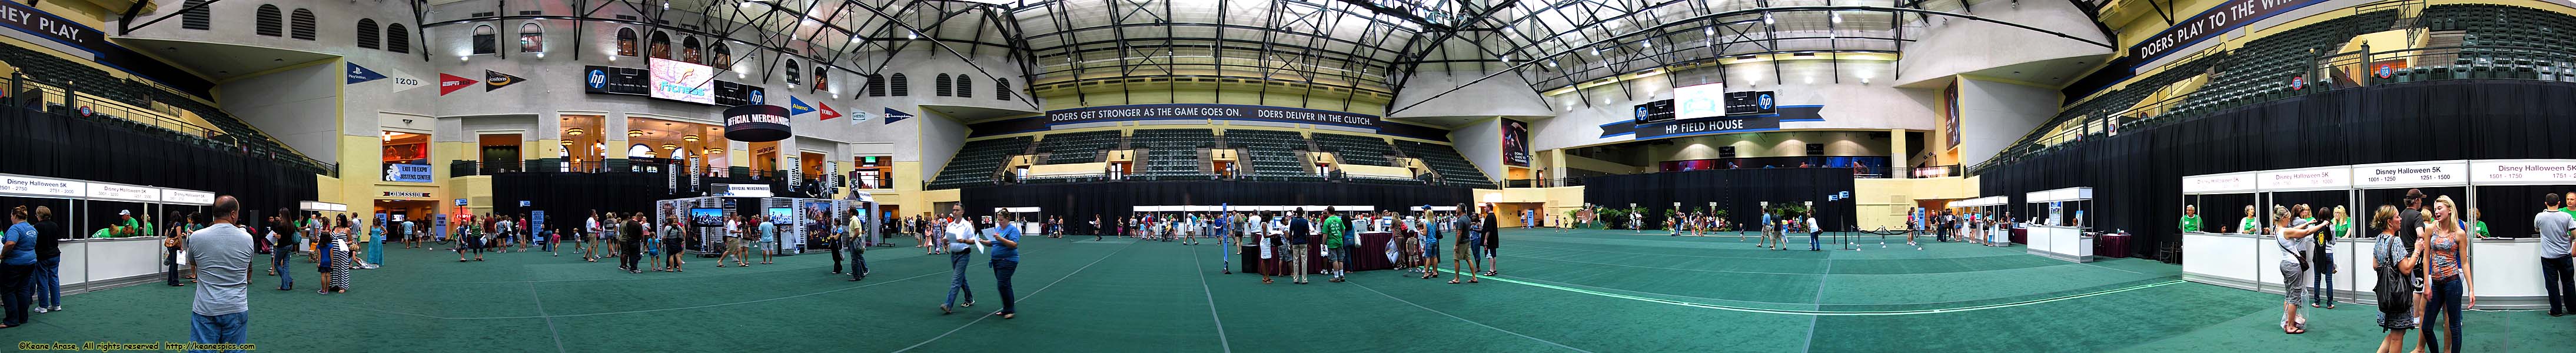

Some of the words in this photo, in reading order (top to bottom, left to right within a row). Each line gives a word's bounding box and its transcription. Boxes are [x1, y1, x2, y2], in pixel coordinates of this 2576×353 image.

[39, 16, 82, 42] PLAY.
[2141, 34, 2173, 59] DOERS
[2178, 19, 2205, 43] PLAY
[2209, 11, 2226, 29] TO
[2231, 0, 2255, 21] THE
[590, 69, 604, 88] hp
[751, 89, 762, 105] hp
[1760, 95, 1771, 110] hp
[792, 103, 808, 111] Alamo
[1052, 112, 1078, 121] DOERS
[1081, 111, 1096, 119] GET
[1098, 109, 1141, 118] STRONGER
[1144, 108, 1155, 116] AS
[1157, 108, 1172, 116] THE
[1174, 108, 1198, 116] GAME
[1201, 108, 1223, 116] GOES
[1226, 108, 1242, 116] ON.
[1638, 108, 1648, 121] hp
[727, 114, 750, 126] OFFICIAL
[1258, 109, 1284, 118] DOERS
[1286, 111, 1315, 121] DELIVER
[1328, 114, 1342, 122] THE
[1344, 116, 1372, 125] CLUTCH.
[1666, 125, 1678, 134] HP
[1681, 122, 1706, 132] FIELD
[1709, 119, 1743, 130] HOUSE
